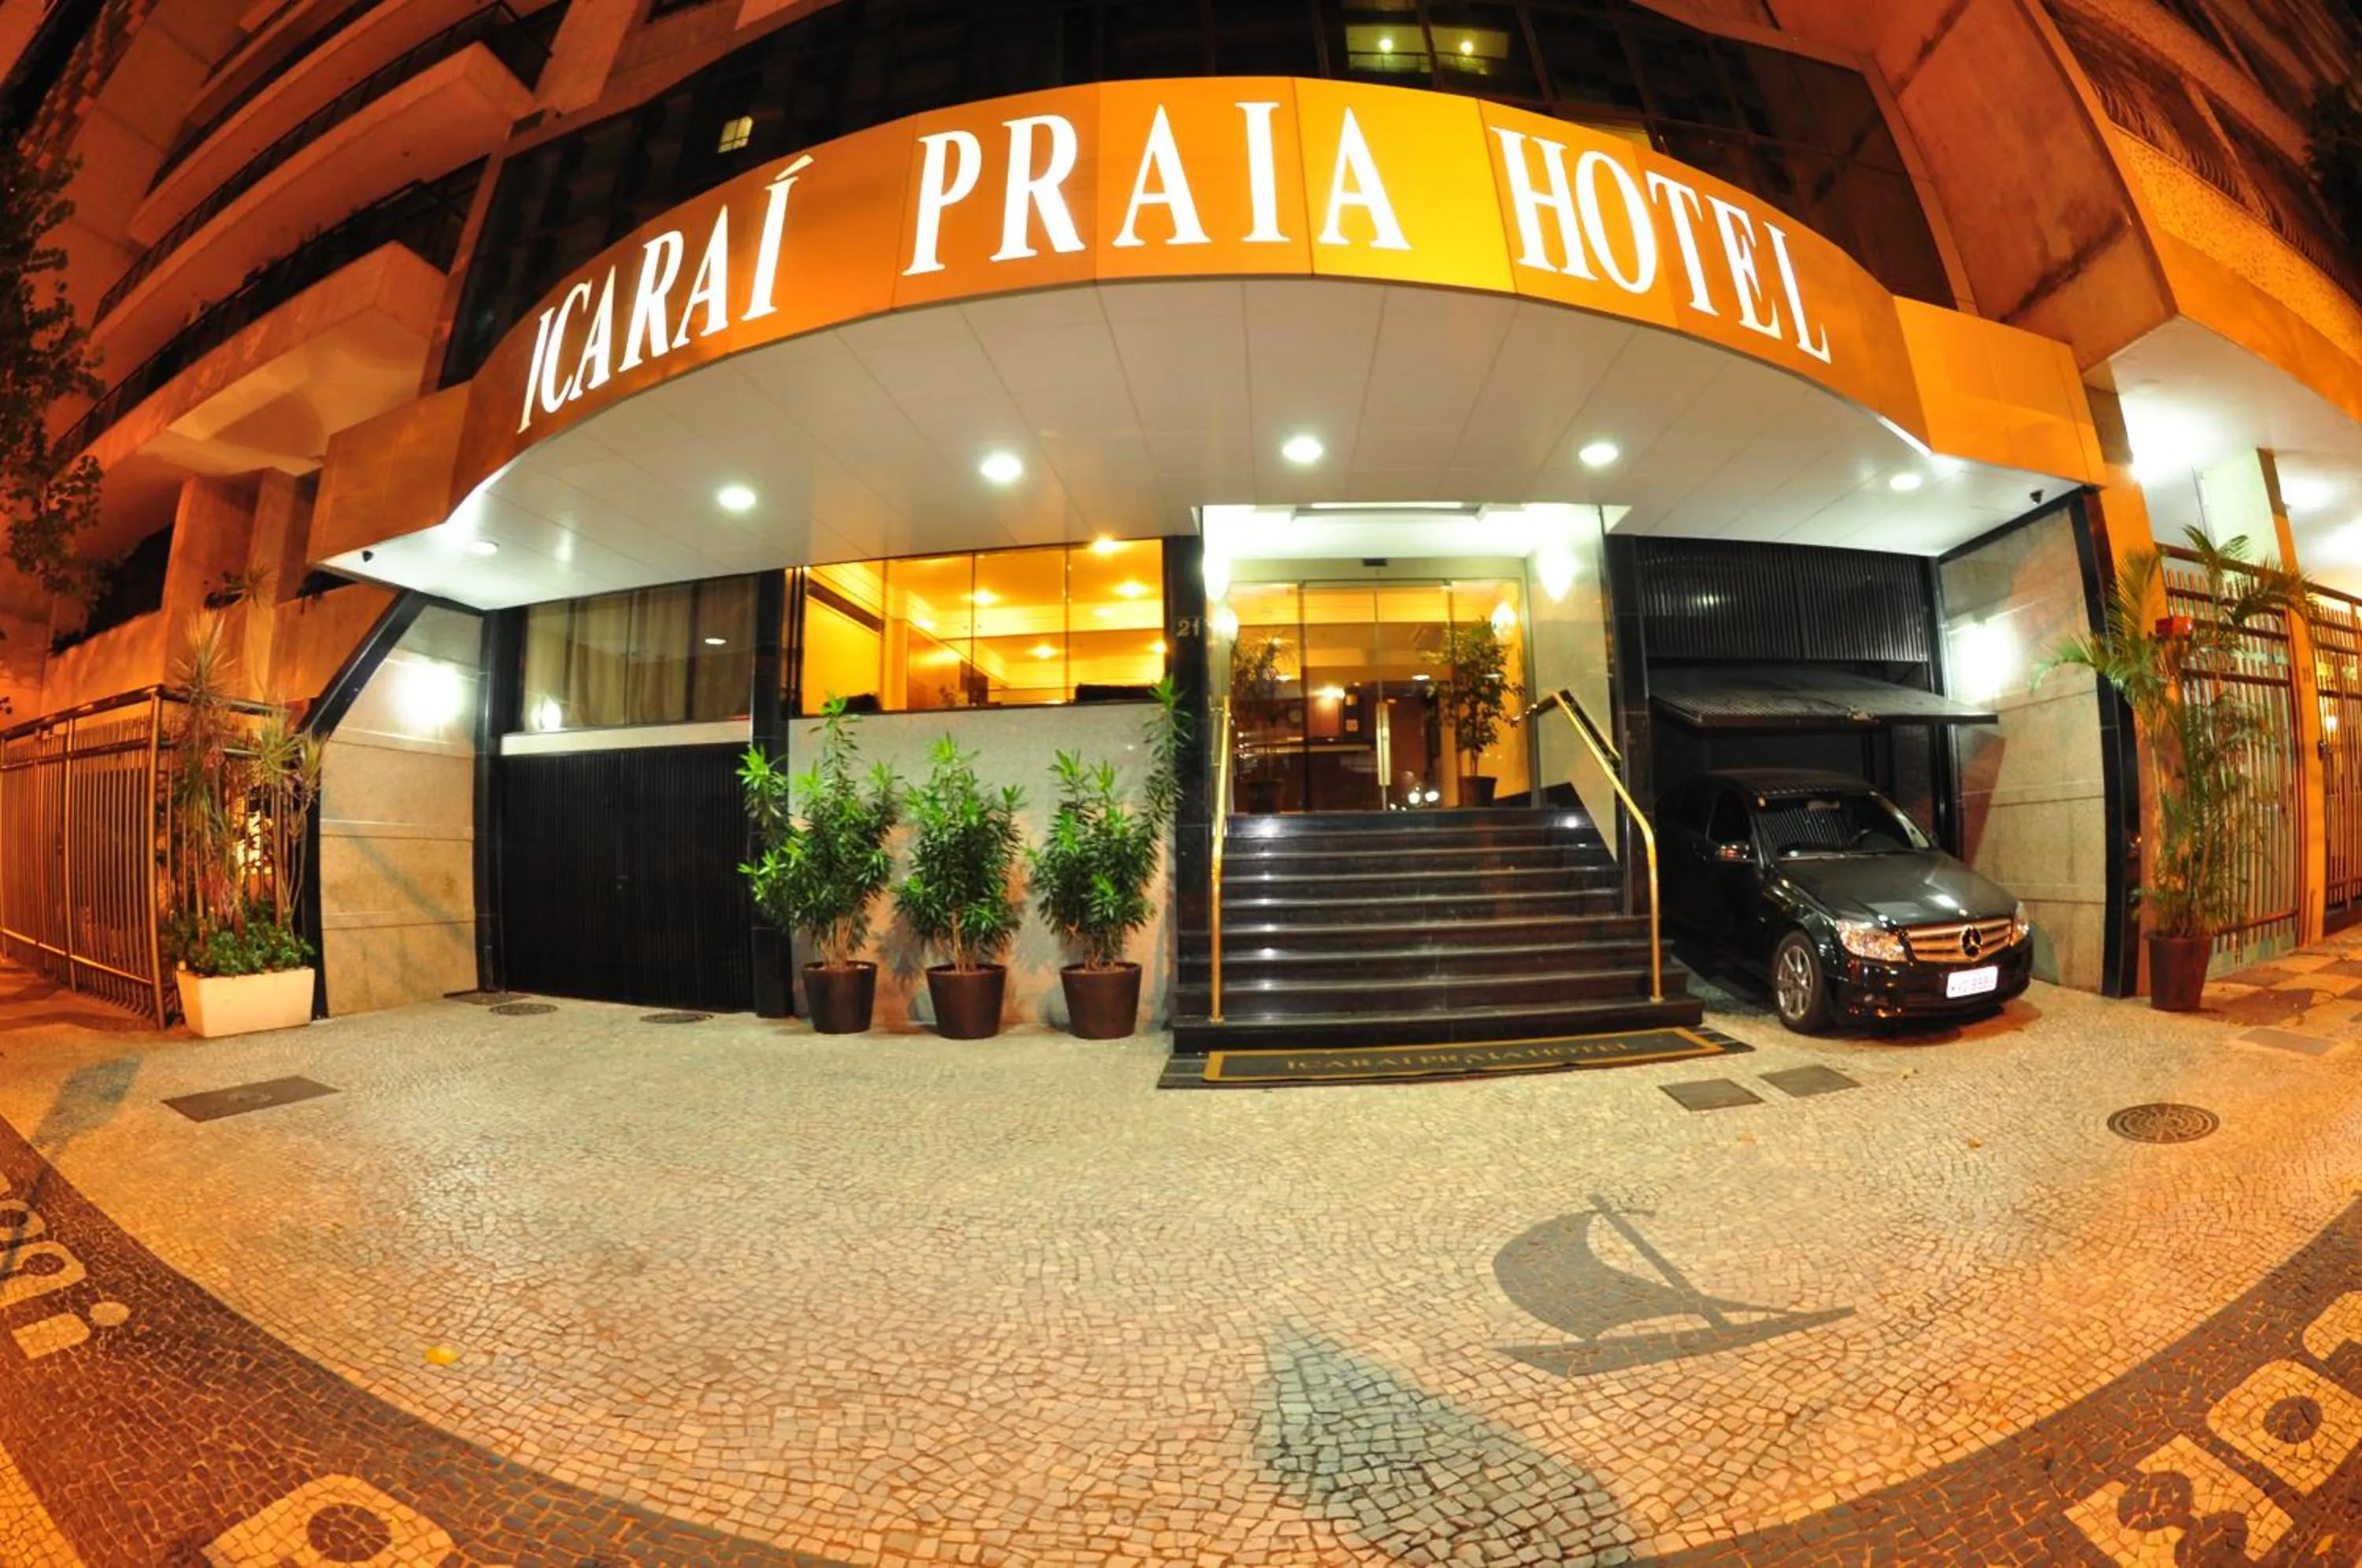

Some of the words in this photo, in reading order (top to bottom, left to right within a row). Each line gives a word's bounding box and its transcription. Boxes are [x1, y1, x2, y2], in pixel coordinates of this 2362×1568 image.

[516, 154, 814, 435] ICARAÍ
[901, 100, 1412, 276] PRAIA
[1490, 126, 1832, 364] HOTEL
